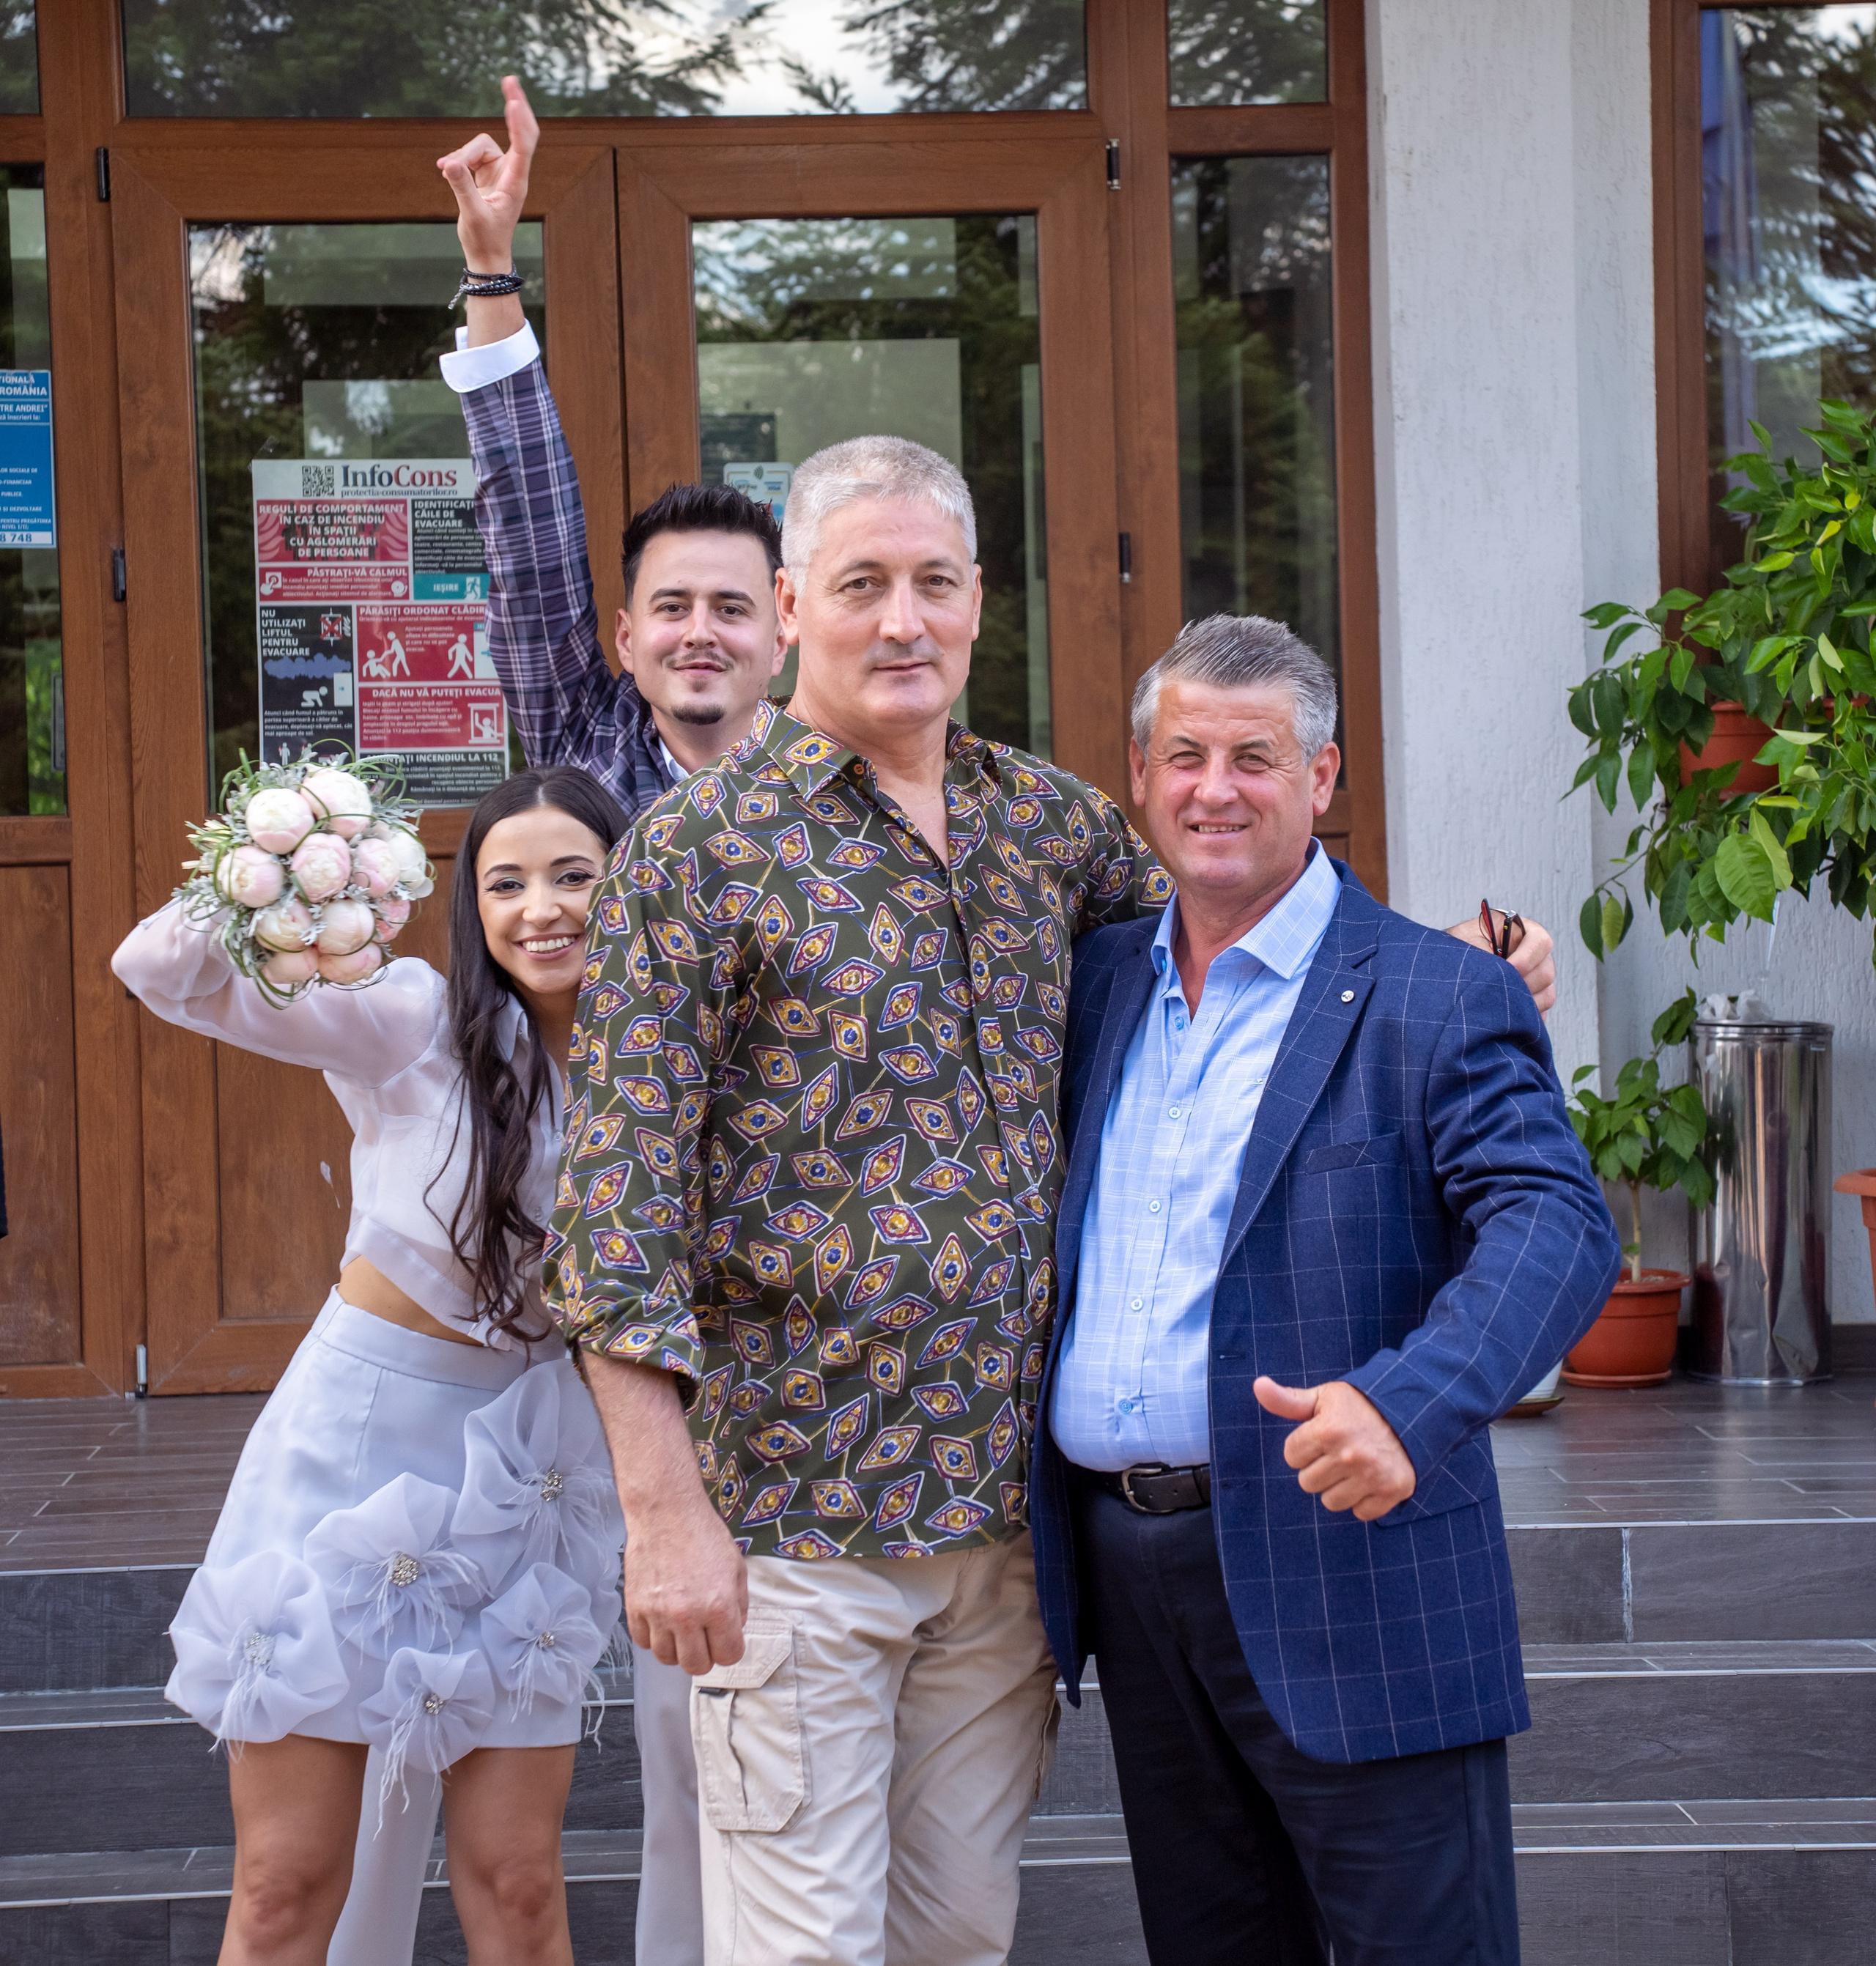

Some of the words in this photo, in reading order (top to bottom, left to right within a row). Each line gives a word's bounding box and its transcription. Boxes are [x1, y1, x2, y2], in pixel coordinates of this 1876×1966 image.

[0, 385, 47, 396] ROMÂNIA
[341, 464, 457, 487] InfoCons
[341, 488, 457, 498] protectia-consumatorilor.ro
[259, 504, 297, 513] REGULI
[300, 505, 313, 513] DE
[315, 504, 404, 513] COMPORTAMENT
[414, 500, 474, 510] IDENTIFICAȚI
[414, 509, 440, 518] CĂILE
[443, 510, 454, 518] DE
[279, 514, 292, 524] ÎN
[295, 515, 315, 524] CAZ
[317, 515, 330, 524] DE
[333, 515, 385, 524] INCENDIU
[415, 519, 462, 528] EVACUARE
[309, 525, 321, 535] ÎN
[324, 526, 356, 536] SPAȚII
[11, 533, 32, 542] 748
[289, 538, 304, 546] CU
[307, 536, 377, 546] AGLOMERĂRI
[298, 548, 311, 557] DE
[314, 547, 369, 557] PERSOANE
[307, 566, 367, 578] PĂSTRAȚI-VĂ
[369, 569, 407, 577] CALMUL
[433, 583, 459, 593] IEȘIRE
[262, 610, 276, 618] NU
[360, 605, 401, 616] PĂRĂSIȚI
[404, 606, 449, 615] ORDONAT
[451, 605, 486, 614] CLĂDIR
[262, 618, 306, 629] UTILIZAȚI
[262, 629, 292, 637] LIFTUL
[262, 638, 298, 646] PENTRU
[262, 648, 310, 656] EVACUARE
[372, 687, 397, 698] DACĂ
[399, 689, 414, 697] NU
[416, 687, 429, 697] VĂ
[431, 688, 462, 698] PUTEȚI
[465, 688, 501, 696] EVACUA
[416, 753, 466, 762] INCENDIUL
[468, 753, 480, 761] LA
[483, 753, 498, 761] 112
